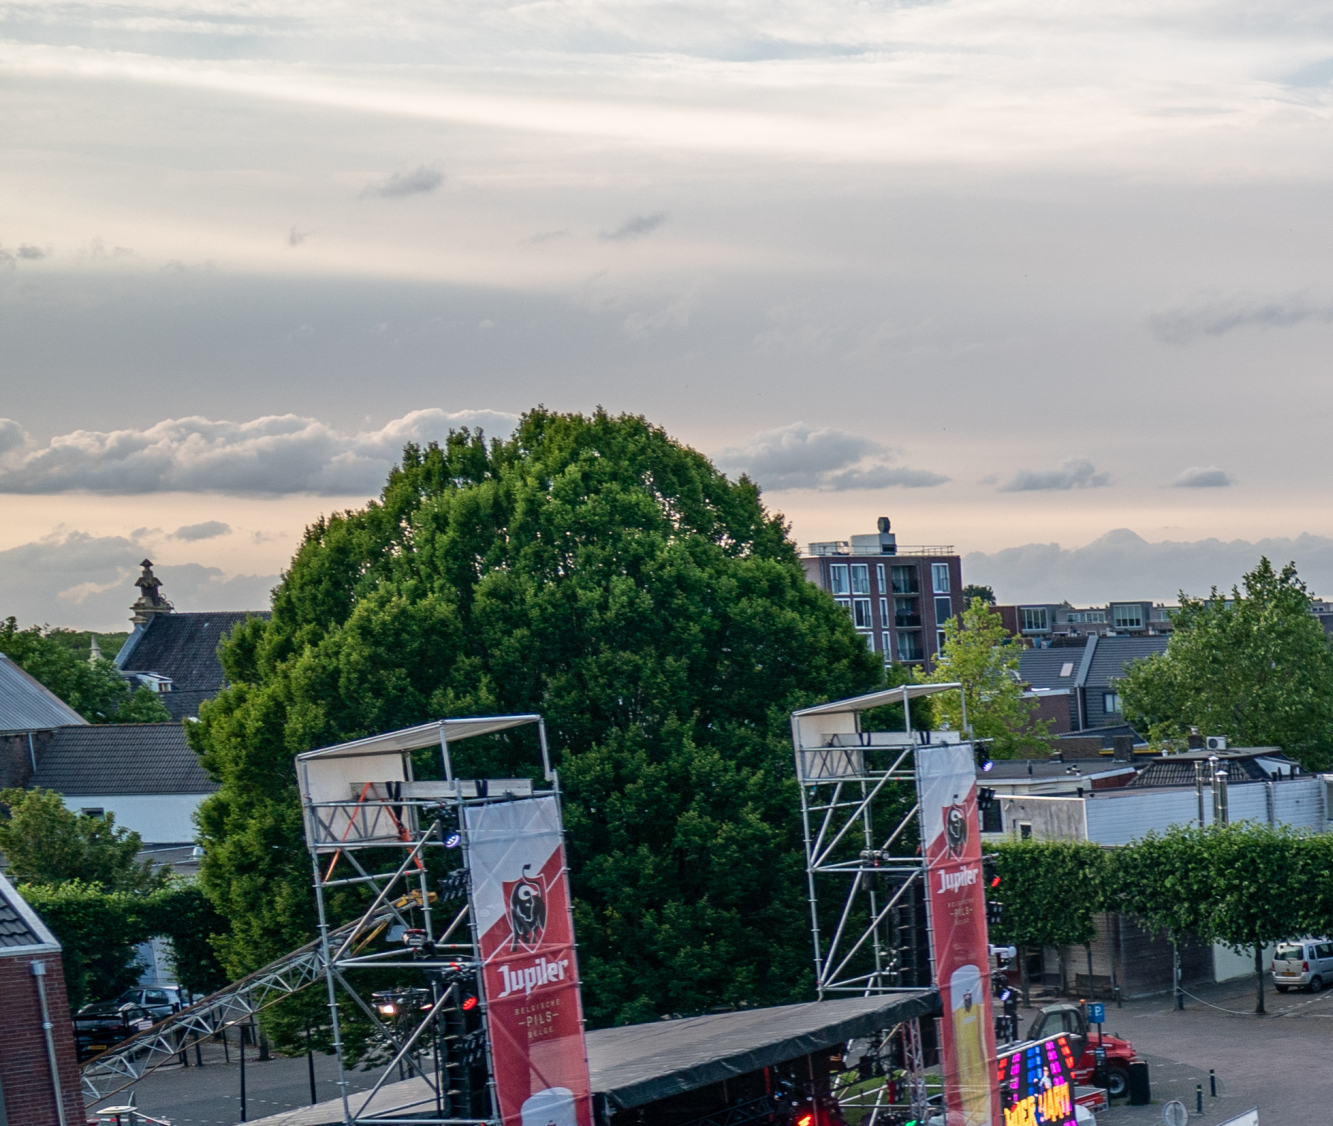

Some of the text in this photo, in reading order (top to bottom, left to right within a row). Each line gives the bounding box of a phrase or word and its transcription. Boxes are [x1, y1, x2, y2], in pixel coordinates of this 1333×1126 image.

[937, 866, 979, 894] Jupiler
[497, 957, 568, 998] Jupiler
[514, 998, 560, 1016] BELGISCHE
